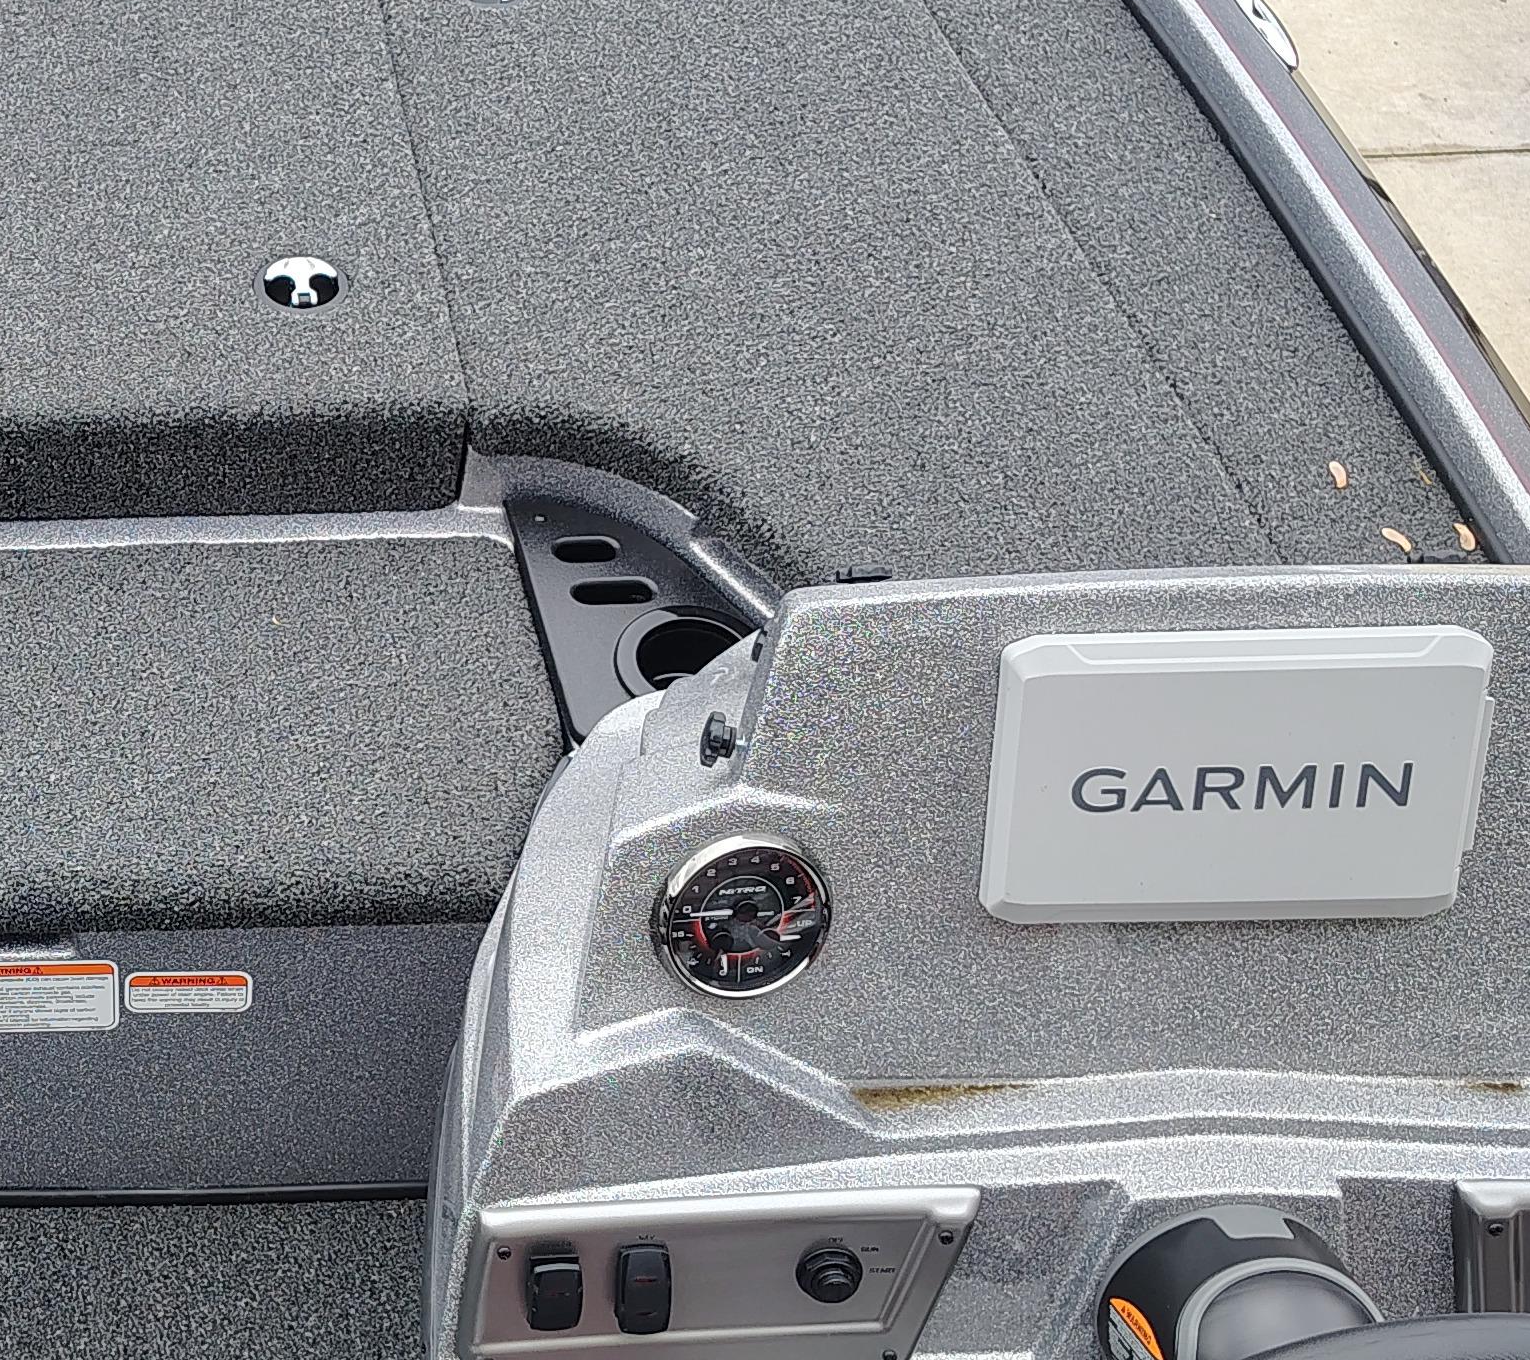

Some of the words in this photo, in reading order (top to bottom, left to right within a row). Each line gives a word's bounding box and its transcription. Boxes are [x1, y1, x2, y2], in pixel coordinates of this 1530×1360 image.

[1071, 762, 1414, 813] GARMIN
[692, 885, 700, 893] 1
[707, 869, 716, 877] 2
[728, 858, 738, 866] 3
[751, 856, 760, 864] 4
[771, 863, 780, 871] 5
[786, 876, 795, 885] 6
[792, 896, 802, 904] 7
[161, 977, 215, 985] WARNING
